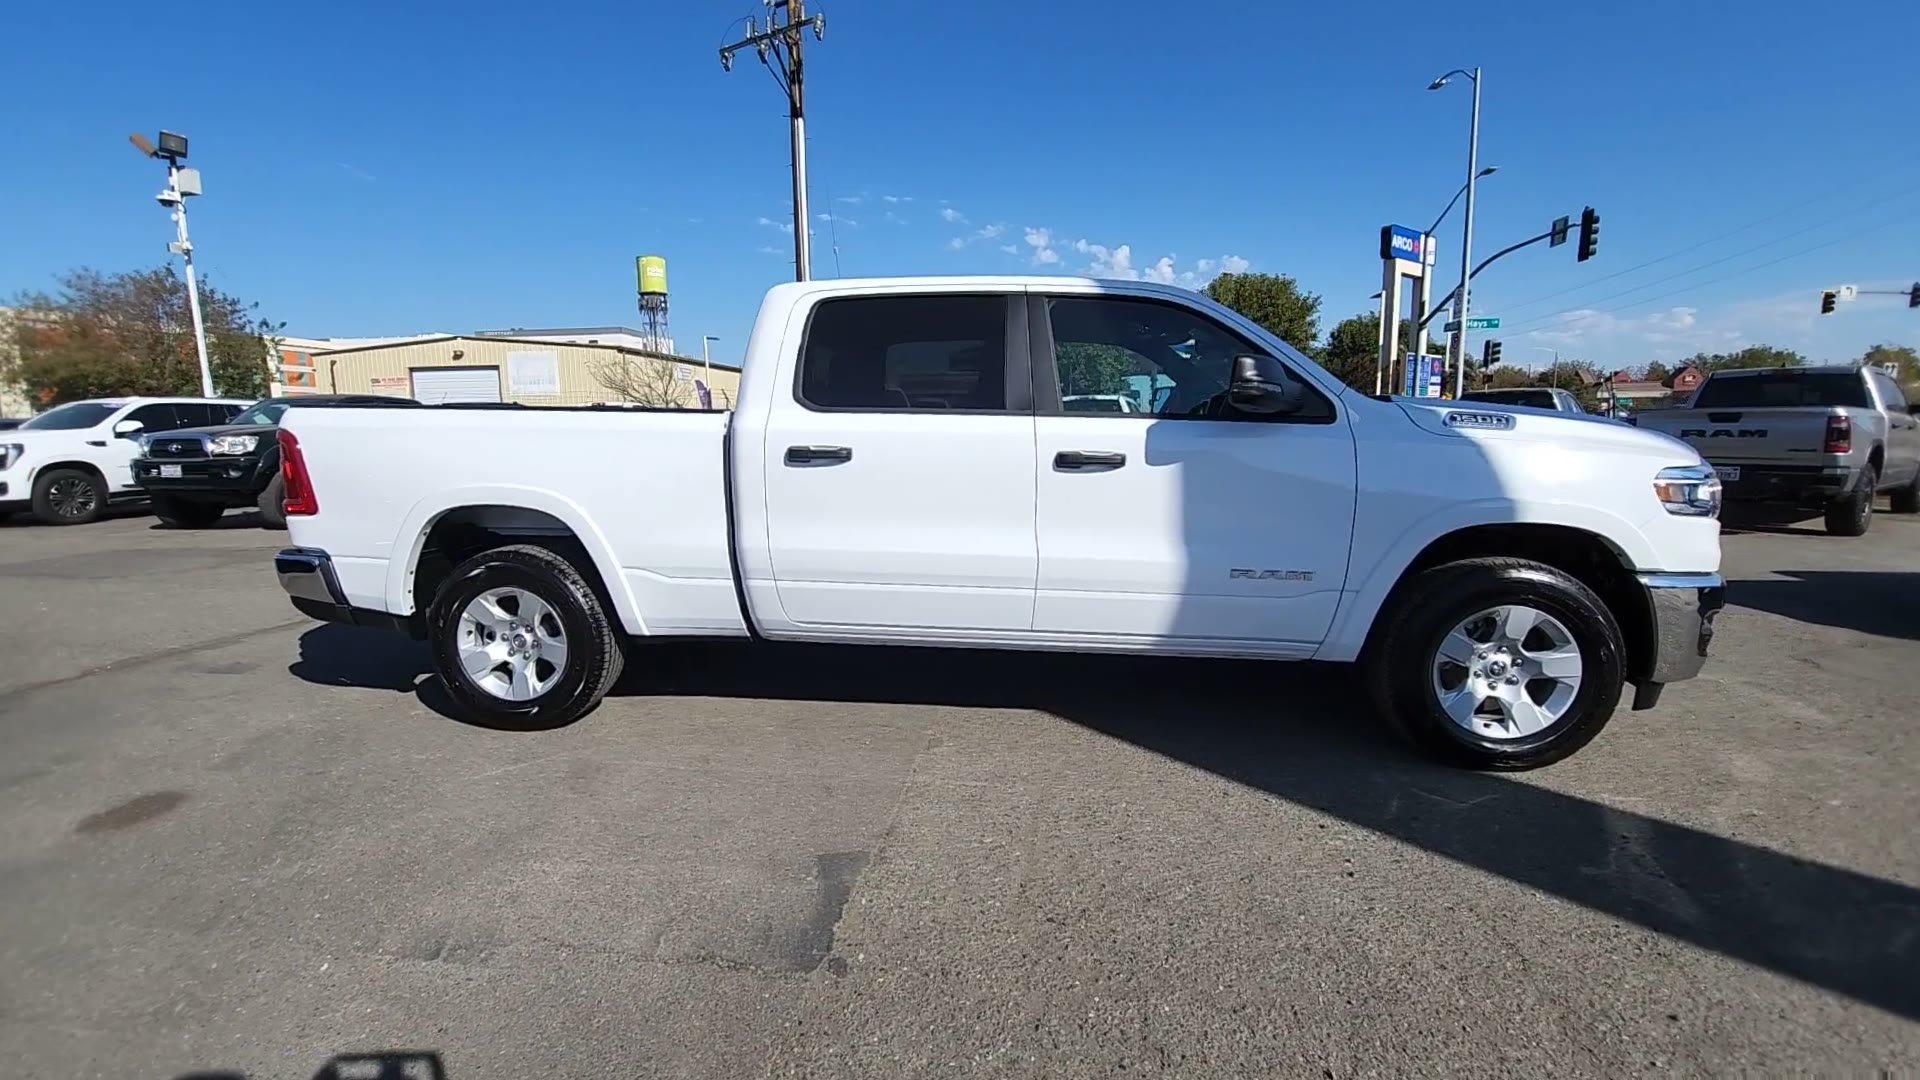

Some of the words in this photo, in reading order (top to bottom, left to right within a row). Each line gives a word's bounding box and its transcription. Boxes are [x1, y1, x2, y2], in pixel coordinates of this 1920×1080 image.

[1391, 234, 1413, 252] ARCO
[1467, 319, 1488, 329] Hays
[1453, 413, 1508, 425] 1500
[1681, 429, 1768, 438] RAM
[1230, 569, 1314, 581] RAM
